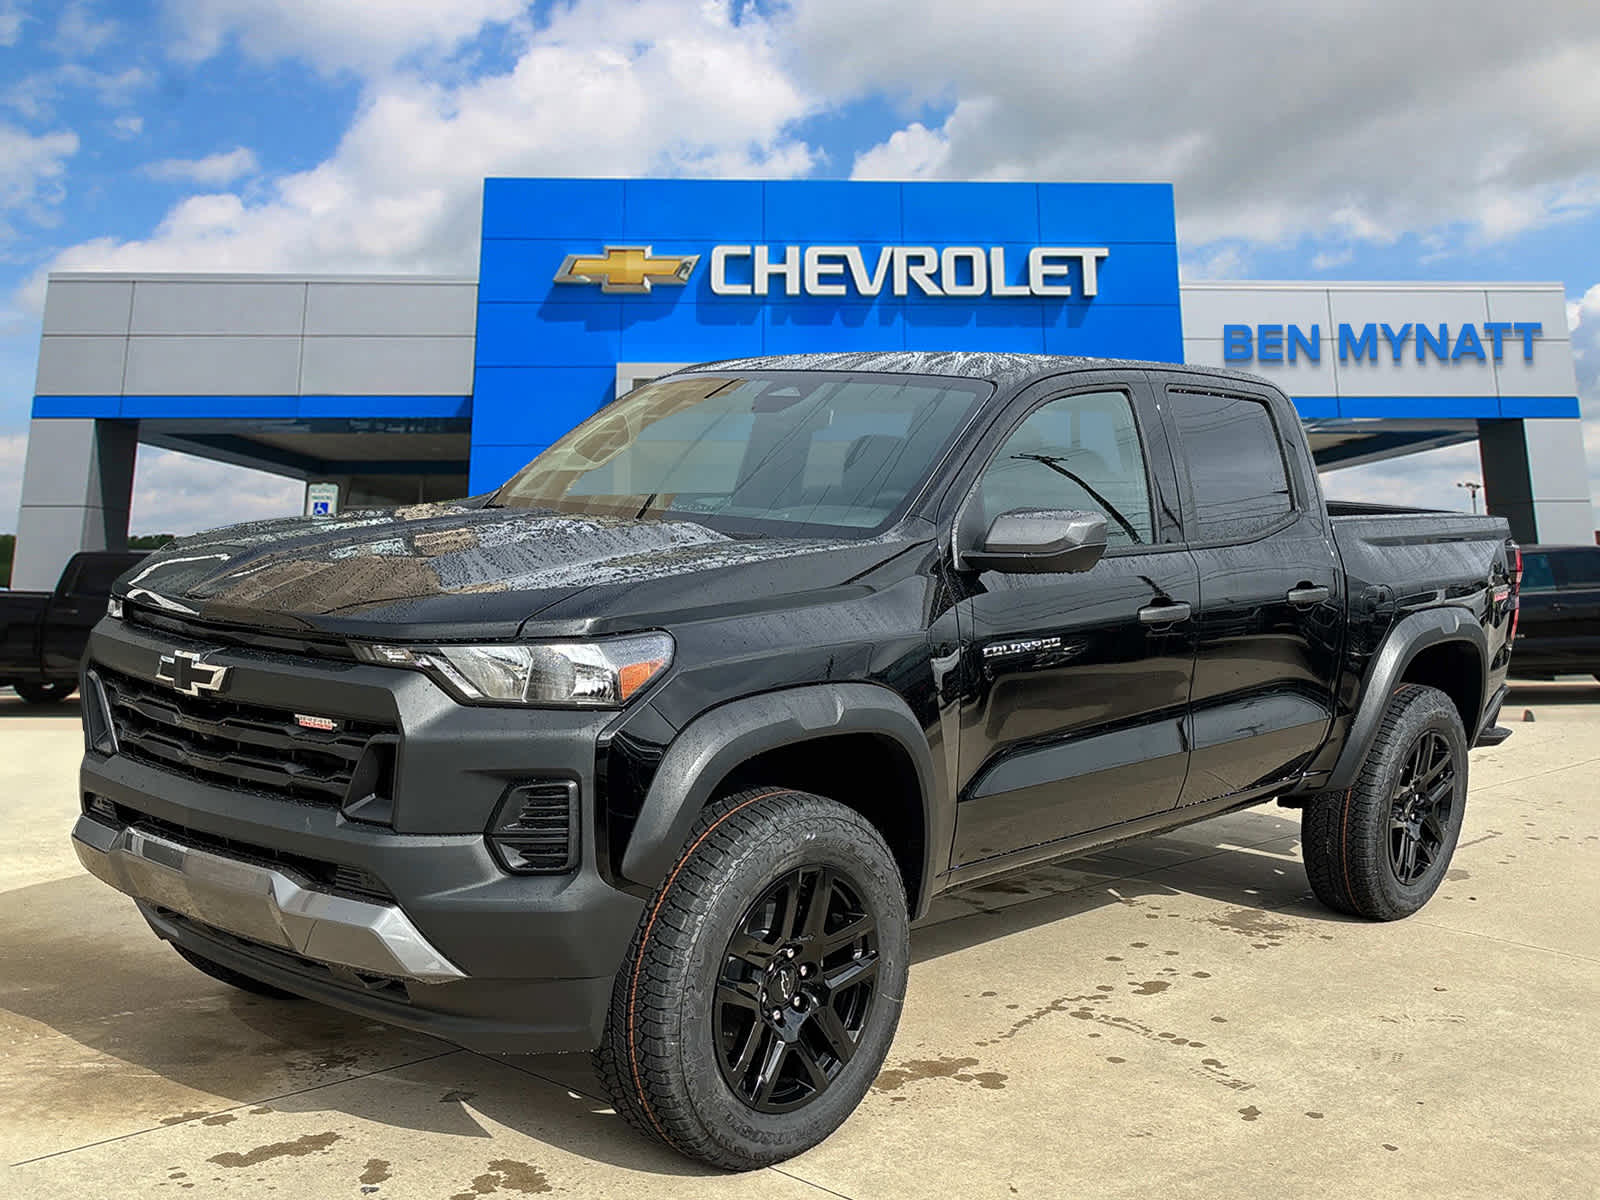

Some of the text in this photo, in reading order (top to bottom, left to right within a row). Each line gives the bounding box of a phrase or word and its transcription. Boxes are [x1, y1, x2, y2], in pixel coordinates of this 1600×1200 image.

[710, 244, 1109, 297] CHEVROLET
[1223, 322, 1543, 363] BEN MYNATT
